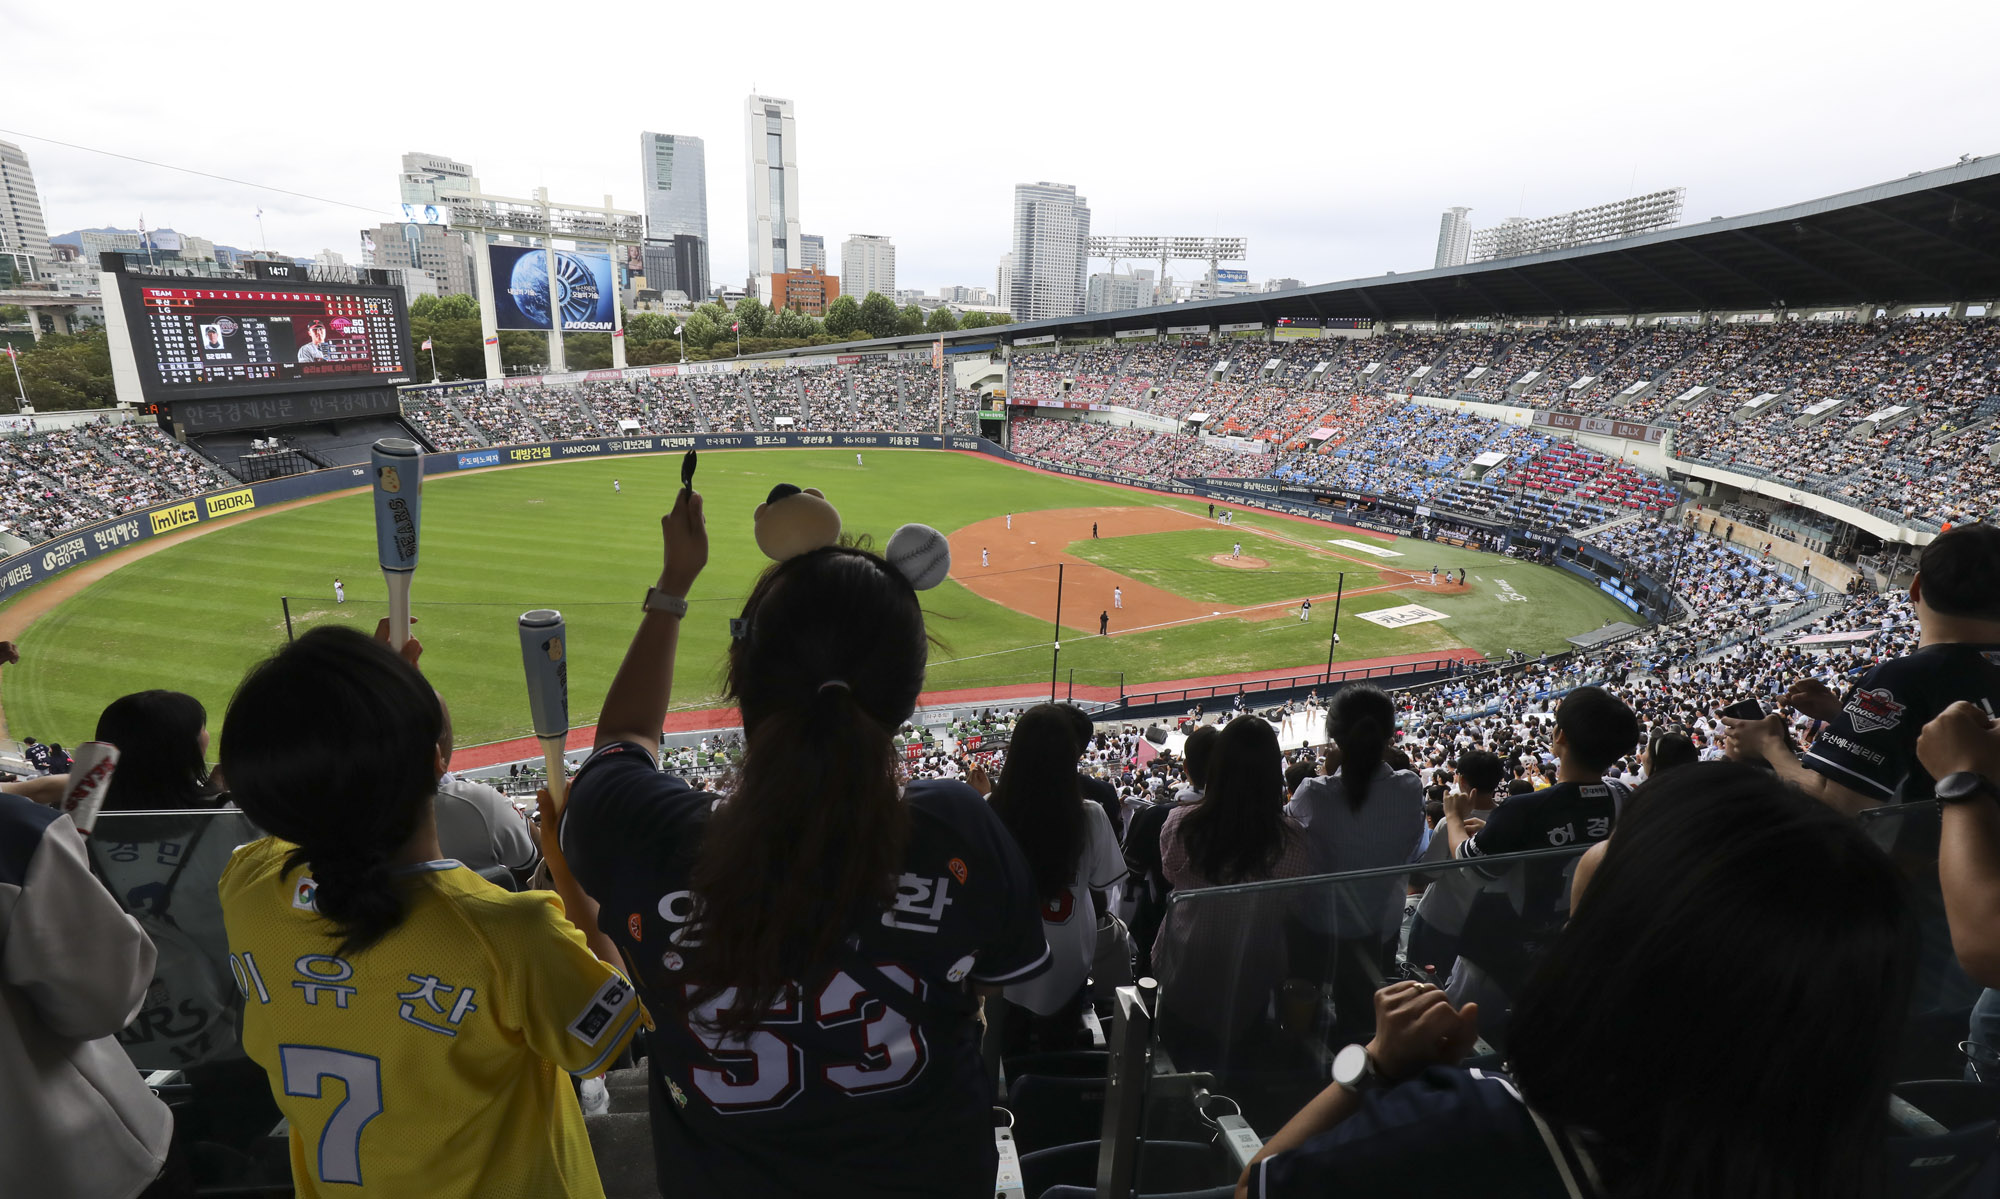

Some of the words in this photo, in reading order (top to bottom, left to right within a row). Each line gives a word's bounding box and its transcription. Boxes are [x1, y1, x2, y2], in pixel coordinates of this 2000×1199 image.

[268, 266, 288, 277] 14:17
[564, 321, 612, 330] DOOSAN
[185, 398, 292, 426] 한국경제신문
[310, 391, 390, 414] 한국경제TV
[1564, 418, 1576, 426] LX
[1595, 423, 1606, 431] LX
[1628, 427, 1639, 436] LX
[622, 439, 652, 450] 대보건설
[660, 437, 695, 448] 치킨마루
[706, 437, 742, 445] 한국경제TV
[889, 436, 919, 446] 키움증권
[511, 446, 551, 460] 대방건설
[562, 444, 600, 455] HANCOM
[466, 454, 499, 465] 도미노피자
[1243, 481, 1279, 493] 충남혁신도시
[208, 494, 253, 513] UBORA
[94, 520, 140, 550] 현대해상
[54, 538, 87, 566] 금강주택
[907, 748, 922, 758] 119
[1821, 731, 1885, 765] 두산에너빌리티
[36, 750, 47, 760] 25
[681, 962, 930, 1115] 53
[278, 1043, 384, 1186] 7
